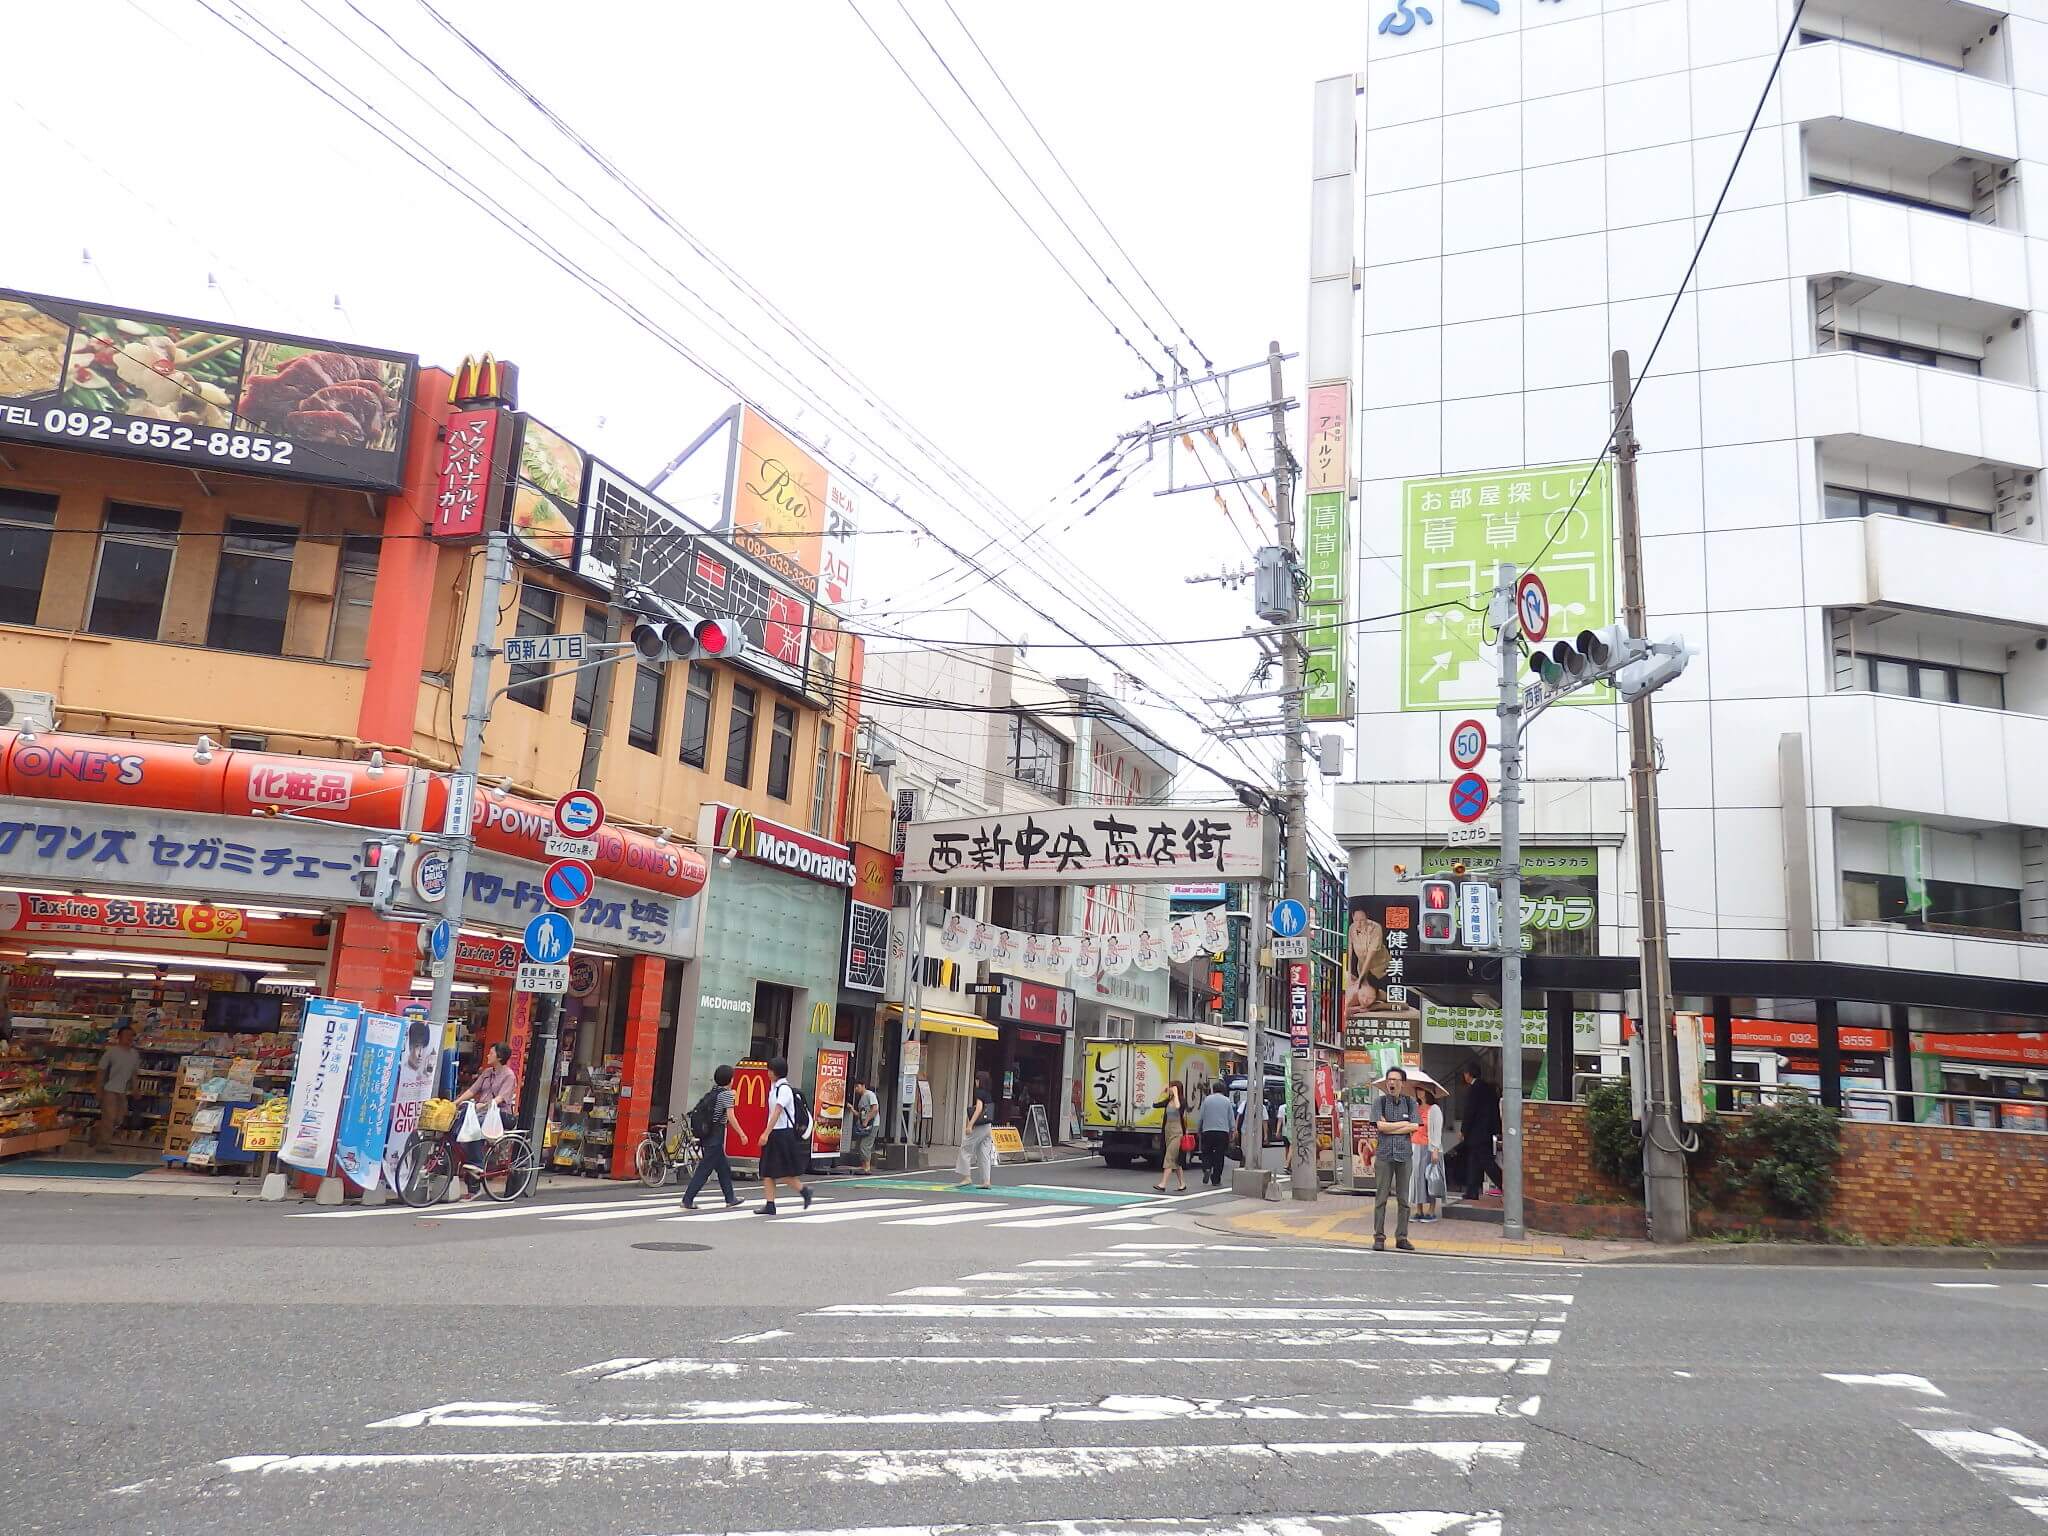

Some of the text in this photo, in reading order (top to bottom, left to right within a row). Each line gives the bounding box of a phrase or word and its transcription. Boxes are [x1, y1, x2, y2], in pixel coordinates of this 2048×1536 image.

[0, 405, 294, 465] TEL 092-852-8852
[1319, 416, 1332, 483] アールツー
[439, 430, 468, 524] ハンバーガー
[461, 419, 488, 522] マクドナルド
[1421, 478, 1592, 512] お部屋探しは
[828, 511, 853, 544] 2F
[824, 552, 850, 586] 入口
[507, 637, 582, 660] 西新4丁目
[1457, 733, 1478, 756] 50
[14, 747, 145, 785] ONE'S
[252, 768, 348, 804] 化粧品
[549, 841, 594, 857] マイクロを除く
[928, 813, 1232, 874] 西新中央商店街
[1451, 828, 1486, 842] ここから
[626, 843, 679, 877] ONE'S
[683, 862, 705, 881] 化粧品
[757, 832, 857, 887] McDonald's
[30, 897, 98, 918] Tax-free
[105, 900, 180, 926] 免税
[631, 898, 669, 927] セガミ
[1469, 887, 1481, 943] 歩車分離信号
[1520, 897, 1594, 930] タカラ
[457, 942, 495, 962] Tax-free
[627, 926, 667, 945] チェーン
[701, 995, 751, 1013] McDonald's
[821, 1065, 844, 1077] ロコモコ
[251, 1138, 266, 1146] 68
